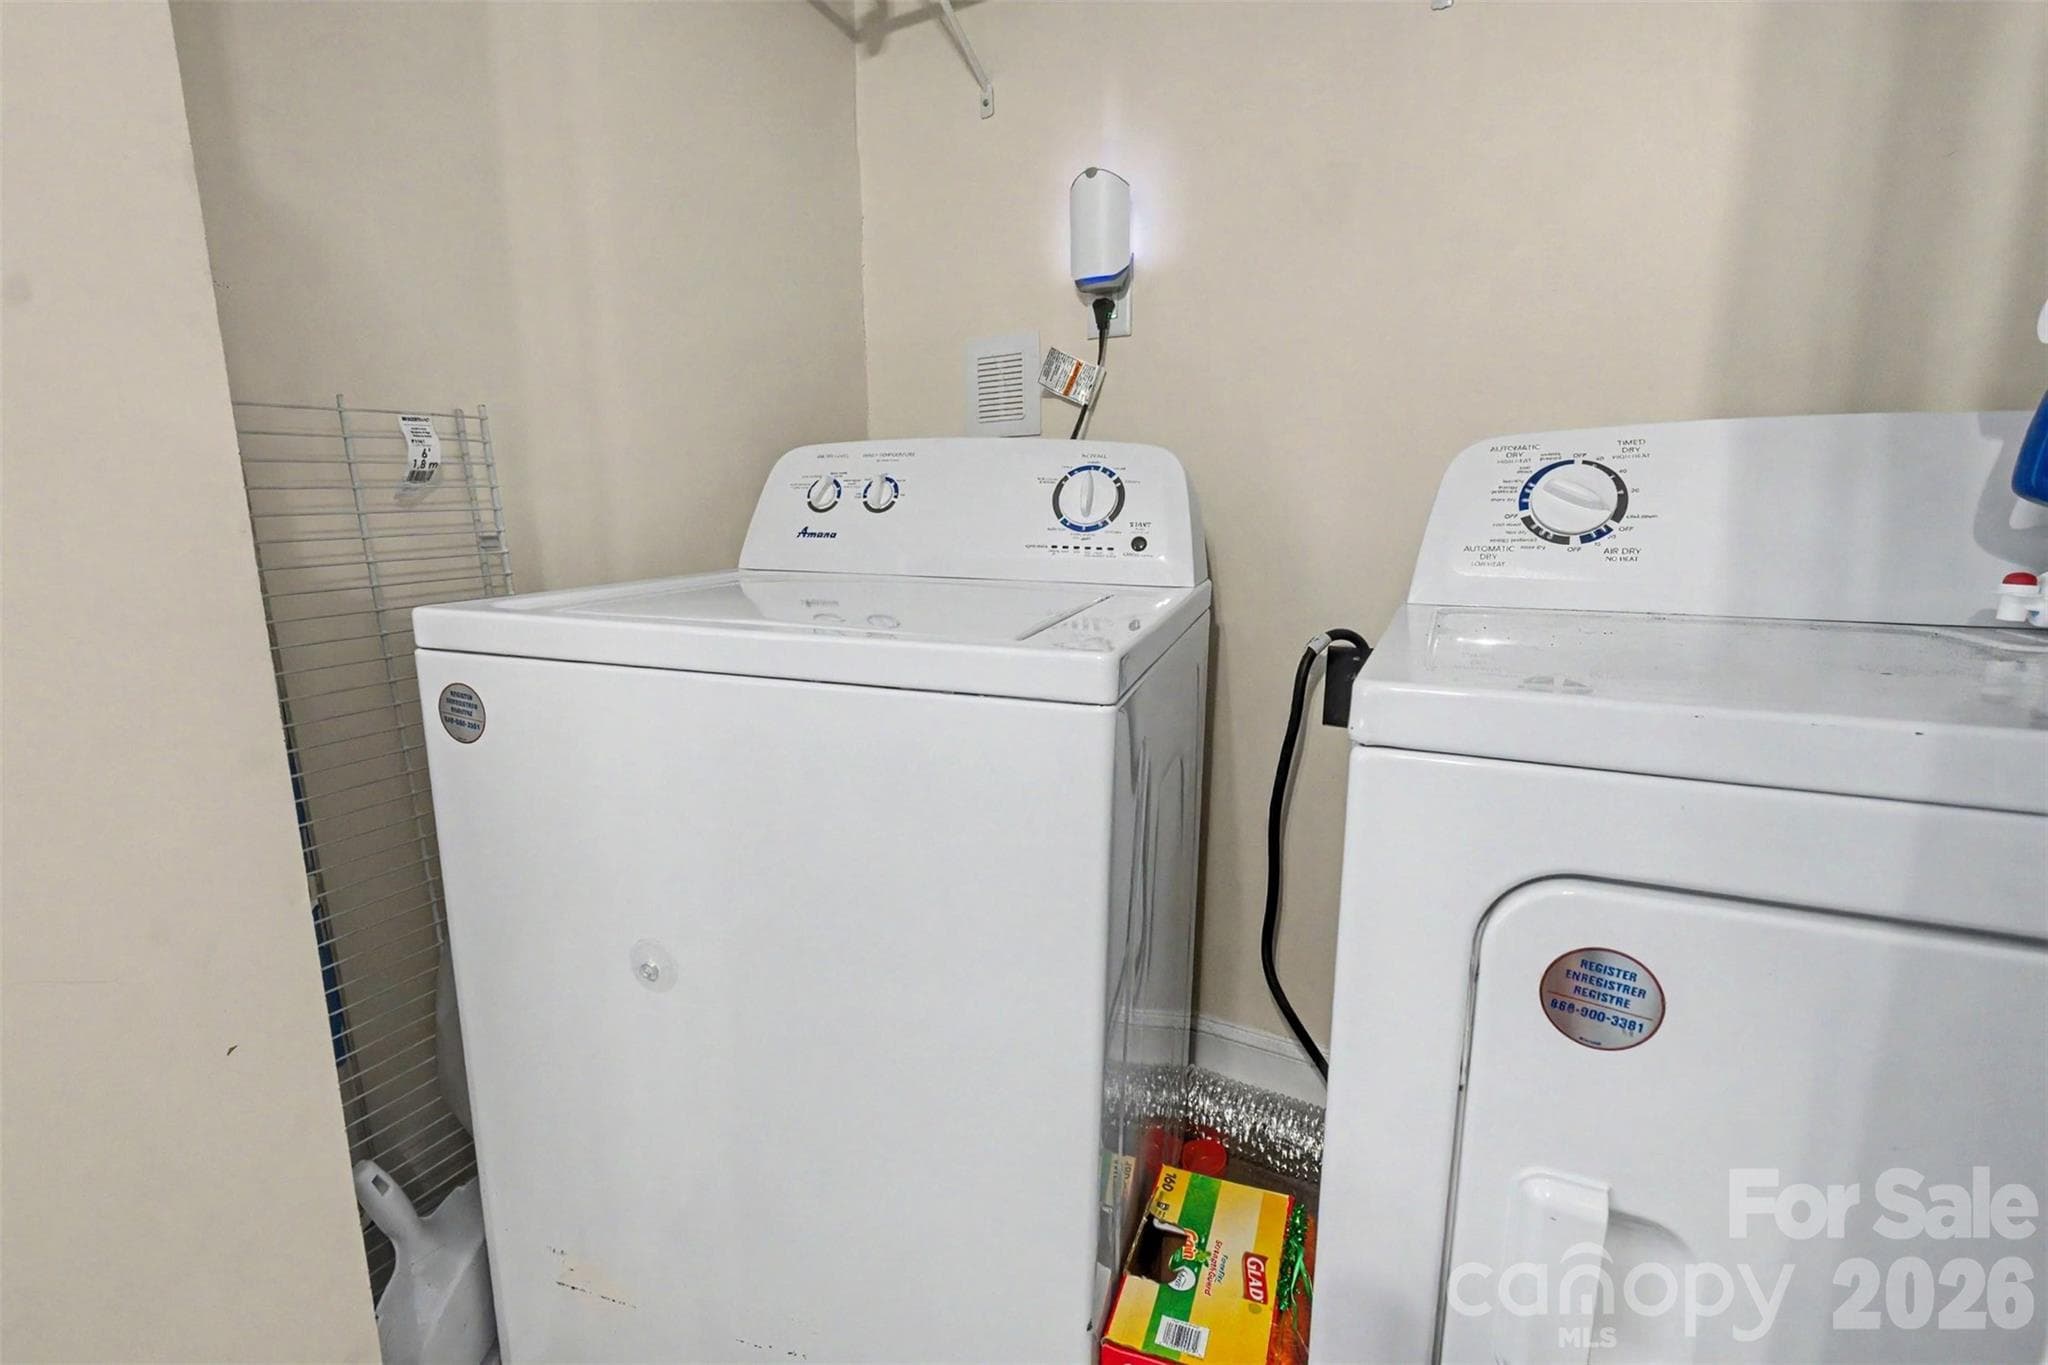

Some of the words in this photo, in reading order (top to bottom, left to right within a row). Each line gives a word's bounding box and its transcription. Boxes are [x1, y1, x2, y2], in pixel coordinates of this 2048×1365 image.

[1490, 444, 1540, 453] AUTOMATIC
[1506, 451, 1524, 459] DRY
[428, 462, 440, 470] m
[797, 526, 838, 539] Amana
[1464, 545, 1515, 553] AUTOMATIC
[1603, 547, 1620, 555] AIR
[1621, 547, 1642, 555] DRY
[1580, 959, 1638, 983] REGISTER
[1566, 969, 1647, 999] ENREGISTRER
[1573, 985, 1631, 1010] REGISTRE
[1162, 1172, 1178, 1193] 160
[1246, 1256, 1266, 1302] GLAD
